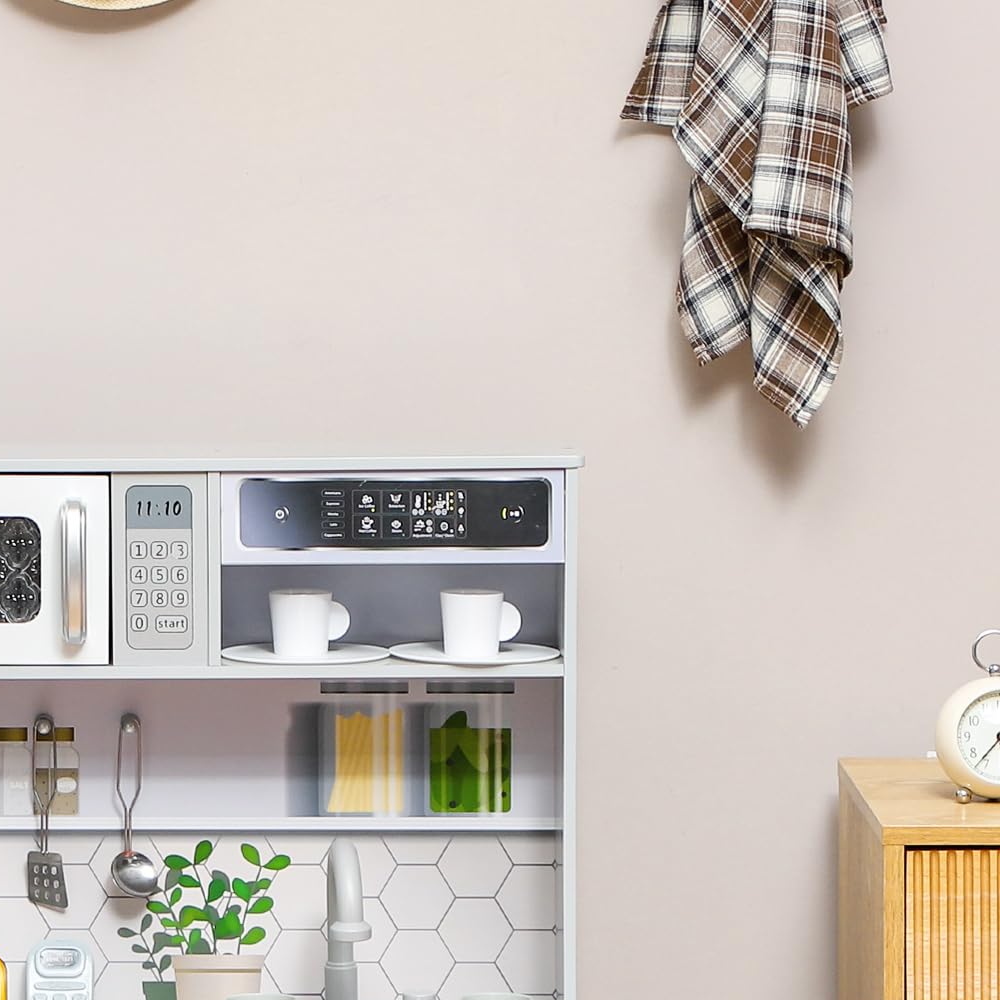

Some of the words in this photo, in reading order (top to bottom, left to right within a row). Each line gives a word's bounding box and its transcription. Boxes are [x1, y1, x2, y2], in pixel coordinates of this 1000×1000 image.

[136, 500, 182, 517] 11:10
[135, 544, 143, 557] 1
[155, 544, 164, 557] 2
[177, 544, 184, 556] 3
[135, 569, 143, 580] 4
[156, 568, 164, 581] 5
[177, 569, 185, 581] 6
[135, 592, 144, 605] 7
[155, 592, 164, 605] 8
[177, 593, 185, 605] 9
[135, 616, 144, 630] 0
[158, 619, 185, 629] start
[969, 715, 979, 726] 10
[964, 731, 971, 742] 9
[970, 747, 977, 758] 8
